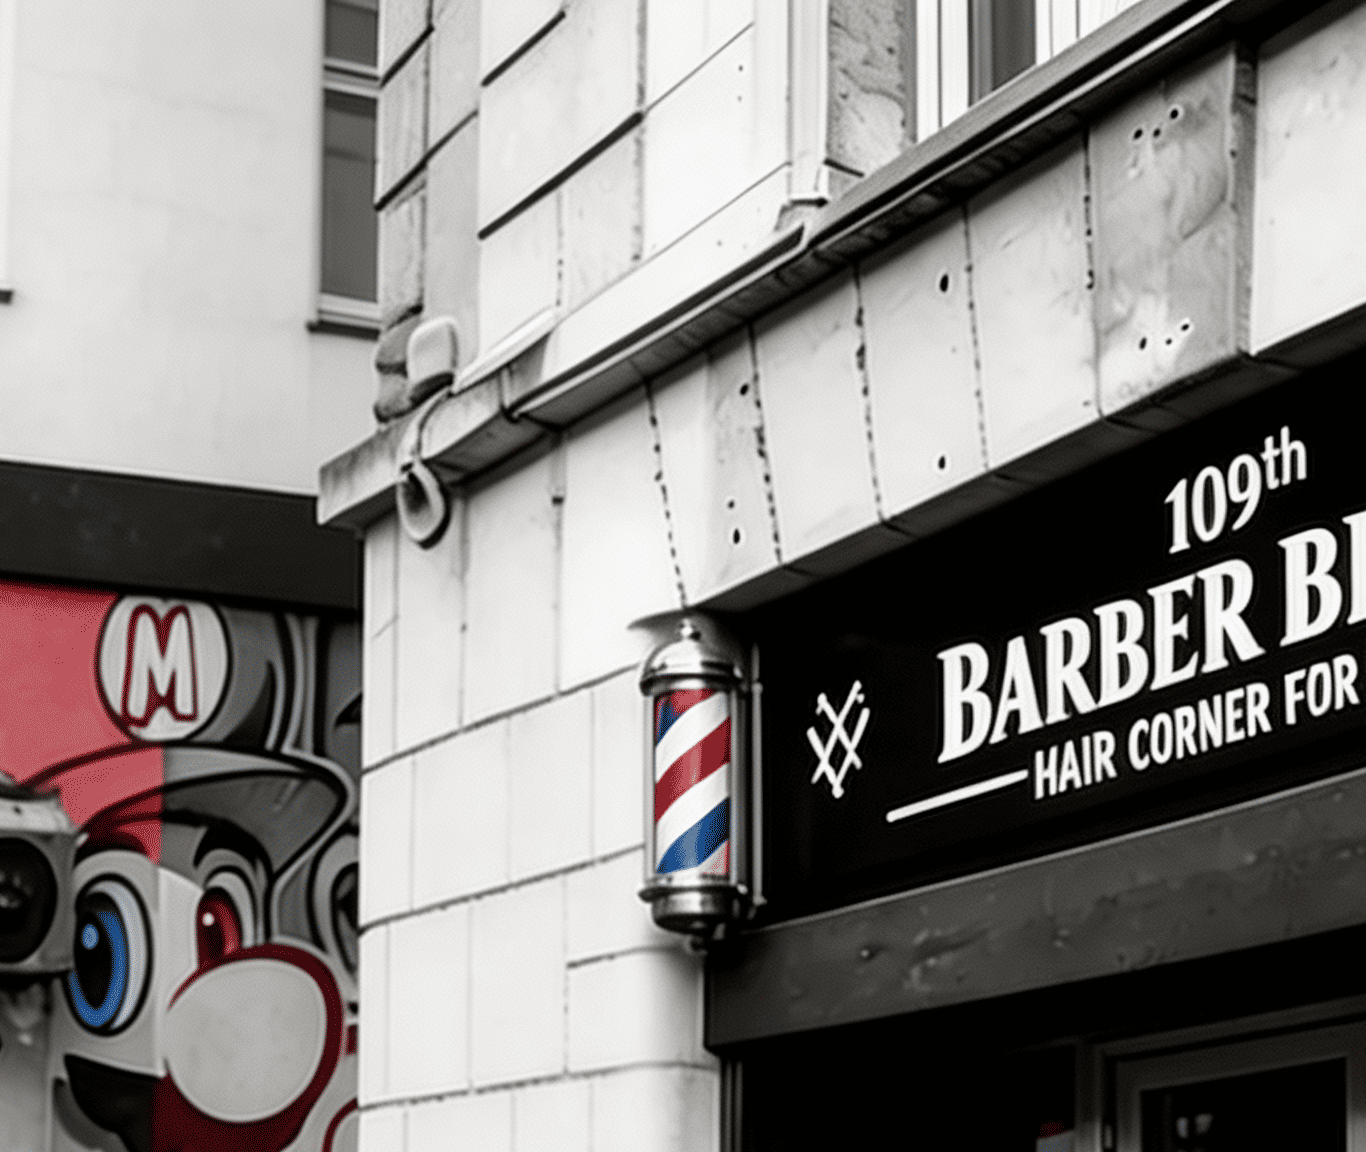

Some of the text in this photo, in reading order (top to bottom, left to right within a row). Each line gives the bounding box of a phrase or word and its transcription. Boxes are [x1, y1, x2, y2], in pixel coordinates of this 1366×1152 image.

[1164, 425, 1307, 554] 109th
[121, 603, 198, 728] M
[936, 558, 1266, 764] BARBER
[1034, 730, 1117, 800] HAIR
[1128, 682, 1272, 771] CORNER
[1284, 653, 1360, 725] FOR
